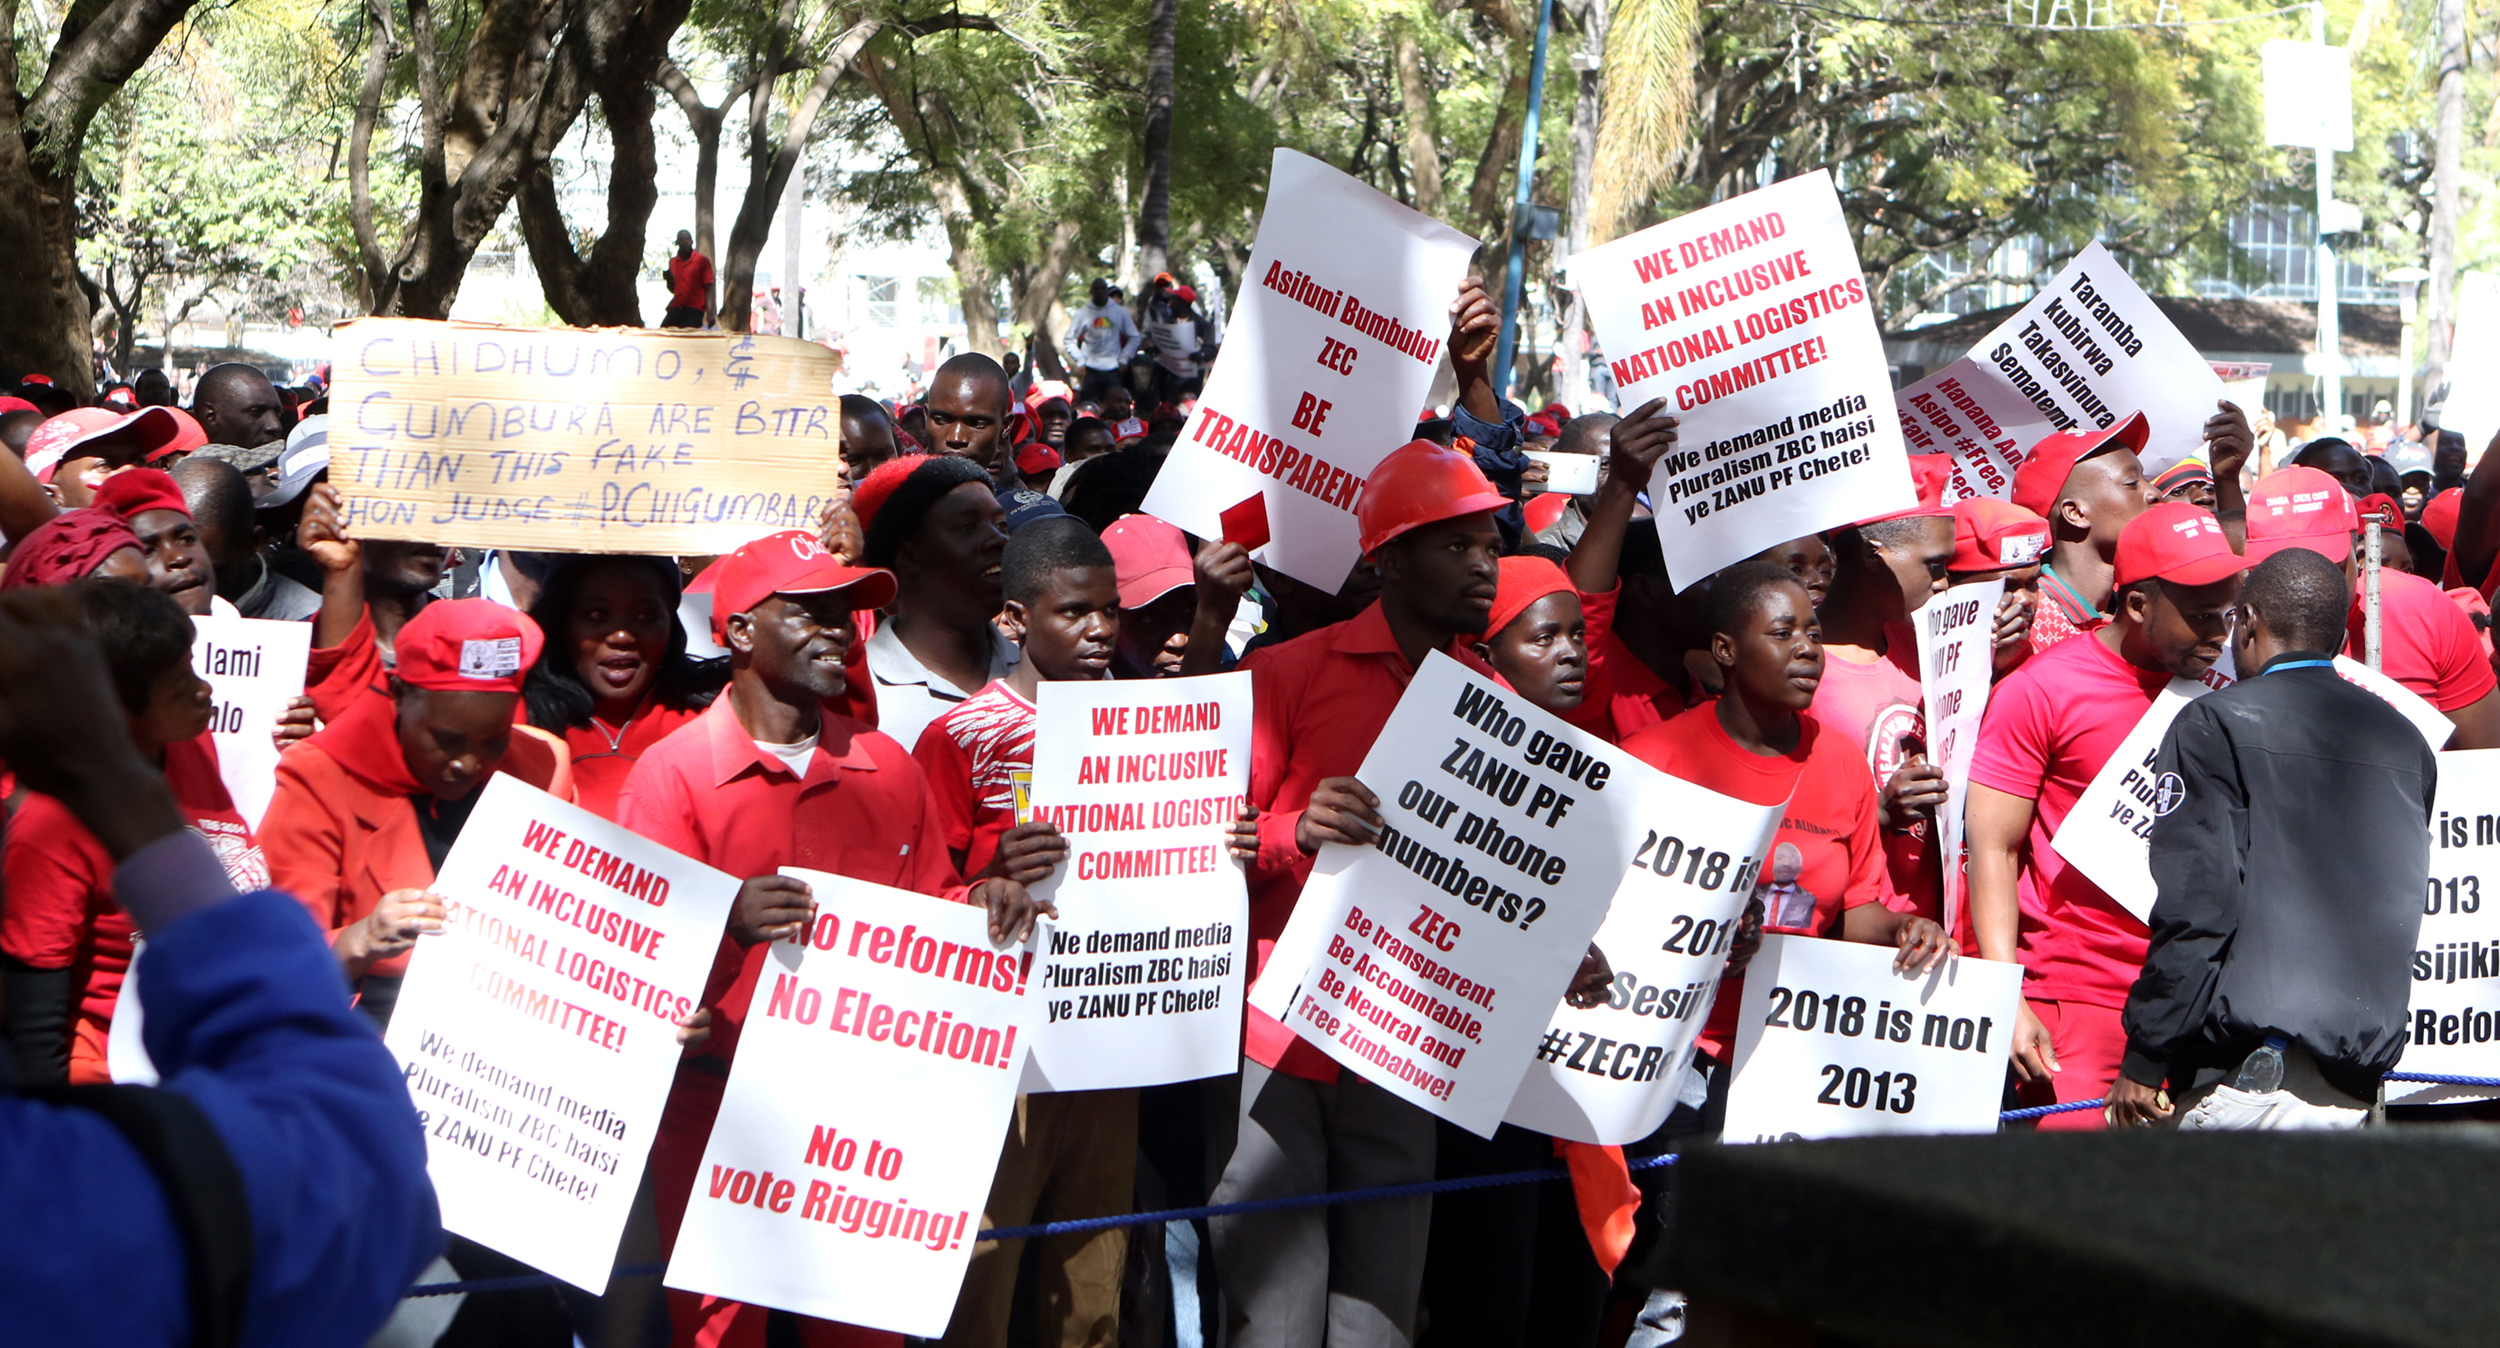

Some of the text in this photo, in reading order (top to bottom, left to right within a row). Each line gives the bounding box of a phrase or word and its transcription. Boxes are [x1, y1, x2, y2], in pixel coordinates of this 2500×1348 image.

[1633, 212, 1786, 284] WE DEMAND
[1263, 259, 1440, 365] Asifuni Bumbulu!
[1641, 249, 1811, 330] AN INCLUSIVE
[2069, 271, 2143, 358] Taramba
[1317, 336, 1358, 376] ZEC
[1611, 278, 1864, 388] NATIONAL LOGISTICS
[2043, 297, 2114, 377] kubirwa
[1675, 336, 1828, 411] COMMITTEE!
[1935, 377, 2002, 440] Hapana
[2018, 320, 2116, 430] Takasvinura
[357, 391, 830, 441] GUMBURA ARE BTTR
[1291, 391, 1332, 437] BE
[1664, 394, 1867, 478] We demand media
[1909, 392, 2005, 495] Asipo #Free,
[490, 449, 569, 483] THIS
[591, 439, 693, 475] FAKE
[1669, 415, 1875, 504] Pluralism ZBC haisi
[1684, 443, 1871, 526] ye ZANU PF Chete!
[347, 502, 416, 526] HON
[433, 493, 553, 524] JUDGE
[1942, 600, 1979, 636] gave
[1945, 641, 1963, 675] PF
[1092, 701, 1221, 736] WE DEMAND
[1453, 682, 1611, 791] Who gave
[1078, 749, 1228, 785] AN INCLUSIVE
[1439, 738, 1575, 828] ZANU PF
[1033, 794, 1245, 833] NATIONAL LOGISTIC
[1398, 779, 1567, 886] our phone
[2109, 799, 2133, 827] ye
[2440, 811, 2468, 849] is
[522, 819, 670, 908] WE DEMAND
[1078, 845, 1217, 880] COMMITTEE!
[1375, 823, 1547, 932] numbers?
[1632, 829, 1730, 891] 2018
[2424, 875, 2480, 916] 013
[488, 864, 666, 961] AN INCLUSIVE
[1086, 926, 1170, 954] demand
[1175, 922, 1232, 951] media
[1408, 904, 1461, 953] ZEC
[437, 893, 692, 1026] ATIONAL LOGISTICS
[847, 921, 1034, 996] reforms!
[1043, 952, 1231, 988] Pluralism ZBC haisi
[1327, 934, 1483, 1045] Be Accountable,
[1344, 906, 1496, 1013] Be transparent,
[2412, 939, 2500, 985] sijiki
[470, 962, 628, 1054] COMMITTEE!
[766, 973, 1018, 1070] No Election!
[1048, 985, 1221, 1024] ye ZANU PF Chete!
[1318, 967, 1467, 1070] Be Neutral and
[1766, 986, 1993, 1055] 2018 is not
[419, 1029, 627, 1141] We demand media
[1298, 994, 1456, 1102] Free Zimbabwe!
[404, 1062, 620, 1176] Pluralism ZBC haisi
[1817, 1064, 1917, 1115] 2013
[433, 1113, 494, 1158] ZANU
[498, 1140, 523, 1168] PF
[527, 1154, 599, 1205] Chete!
[804, 1124, 904, 1181] No to
[708, 1164, 969, 1252] vote Rigging!
